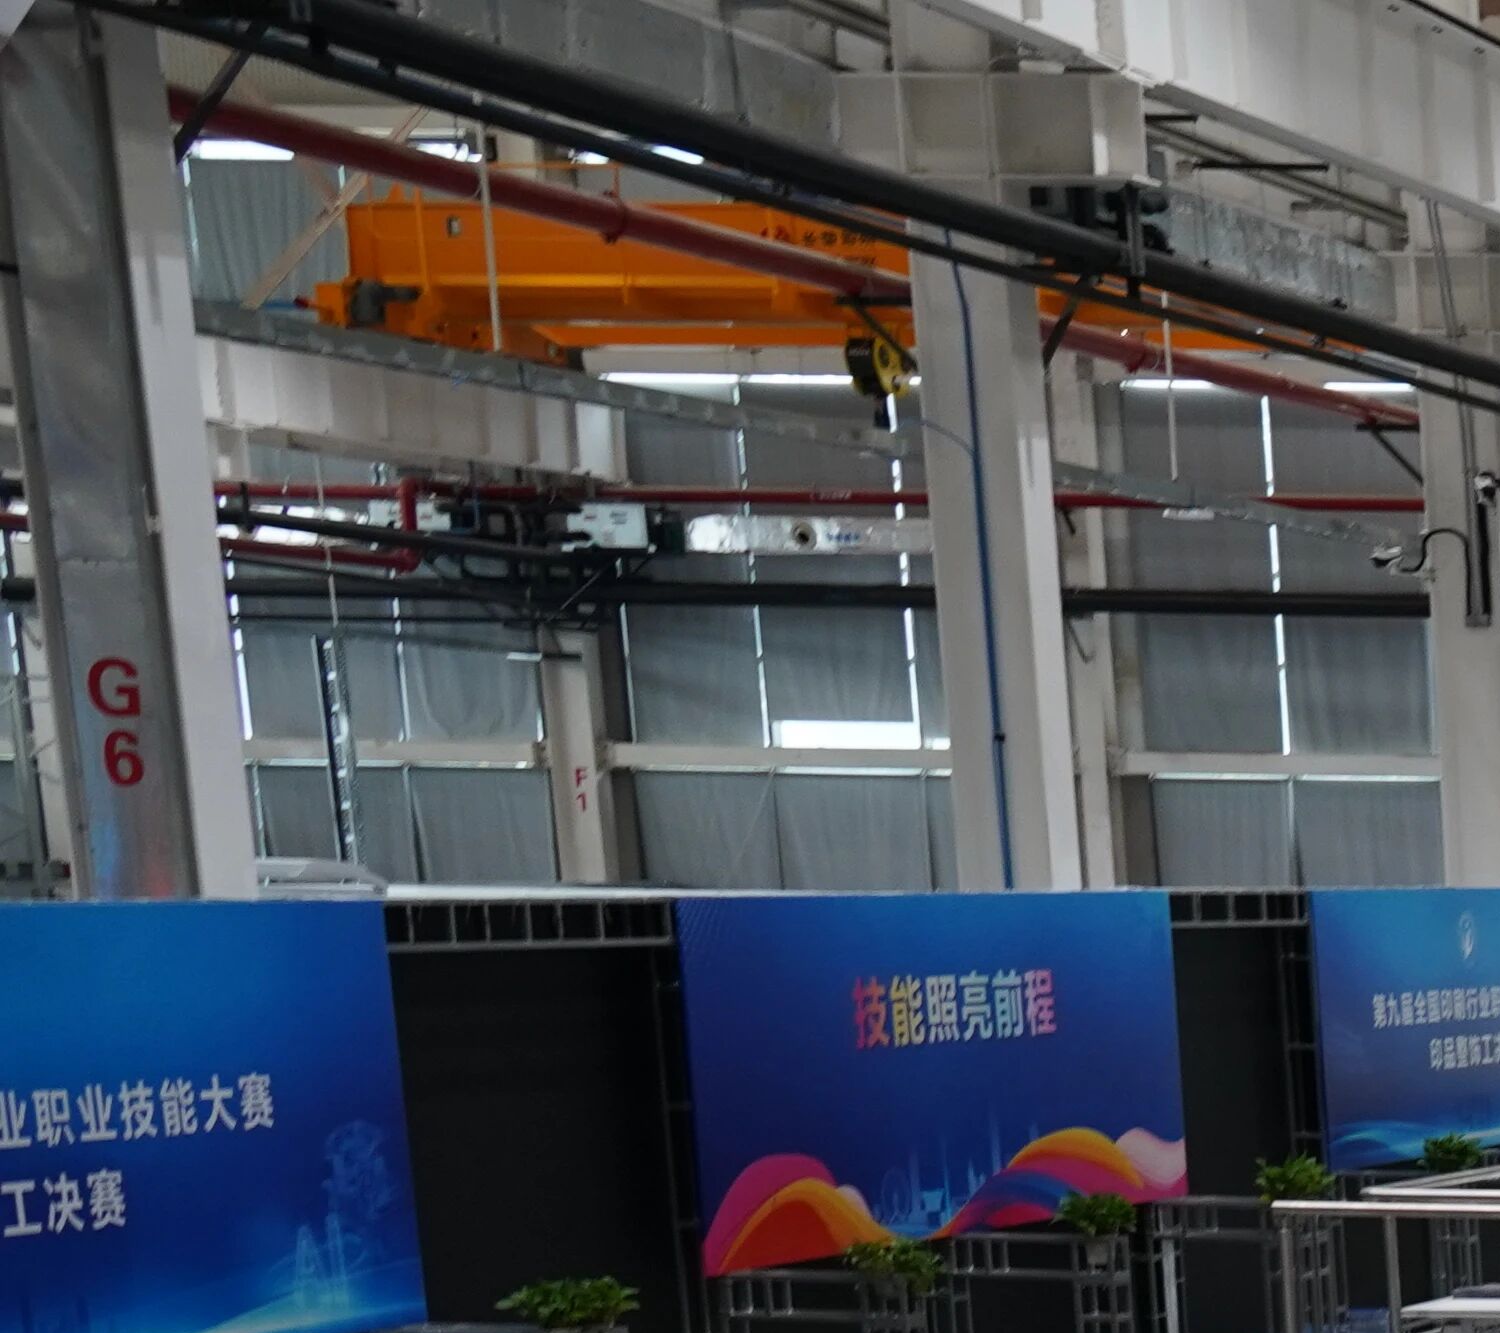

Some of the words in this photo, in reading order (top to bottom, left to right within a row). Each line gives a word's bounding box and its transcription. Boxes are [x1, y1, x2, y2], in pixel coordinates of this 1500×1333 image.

[87, 657, 141, 717] G
[103, 729, 144, 787] 6
[853, 968, 1057, 1049] 技能照亮前程
[0, 1072, 275, 1150] 业职业技能大赛
[0, 1168, 127, 1238] 工决赛
